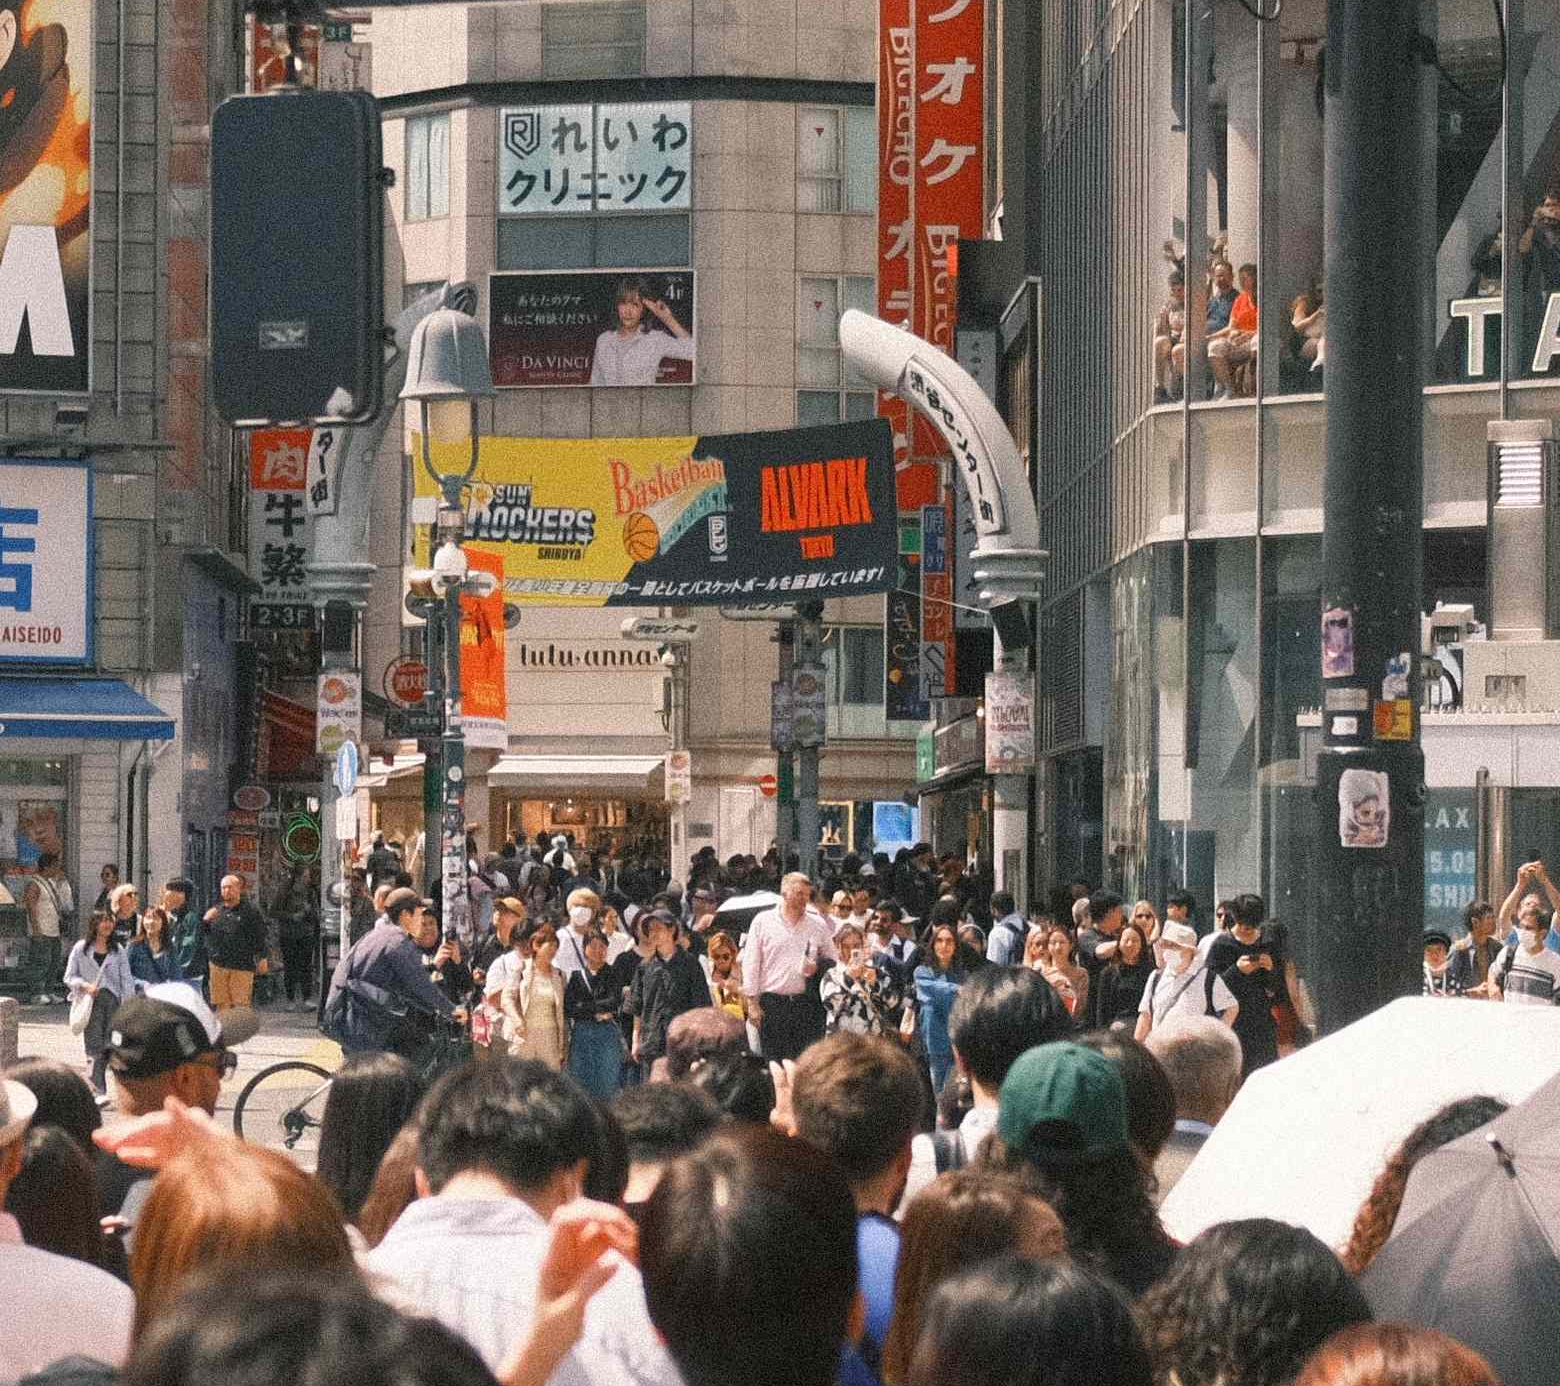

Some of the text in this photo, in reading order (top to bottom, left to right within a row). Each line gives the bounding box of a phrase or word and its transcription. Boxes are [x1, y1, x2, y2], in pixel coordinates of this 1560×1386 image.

[888, 27, 911, 186] BIG ECHO
[548, 113, 688, 155] れいわ
[504, 163, 688, 209] クリニック
[521, 356, 590, 370] DA VINCI
[263, 441, 304, 483] 肉
[495, 485, 531, 504] SUN
[762, 457, 872, 532] ALVARK
[262, 493, 307, 587] 牛繁
